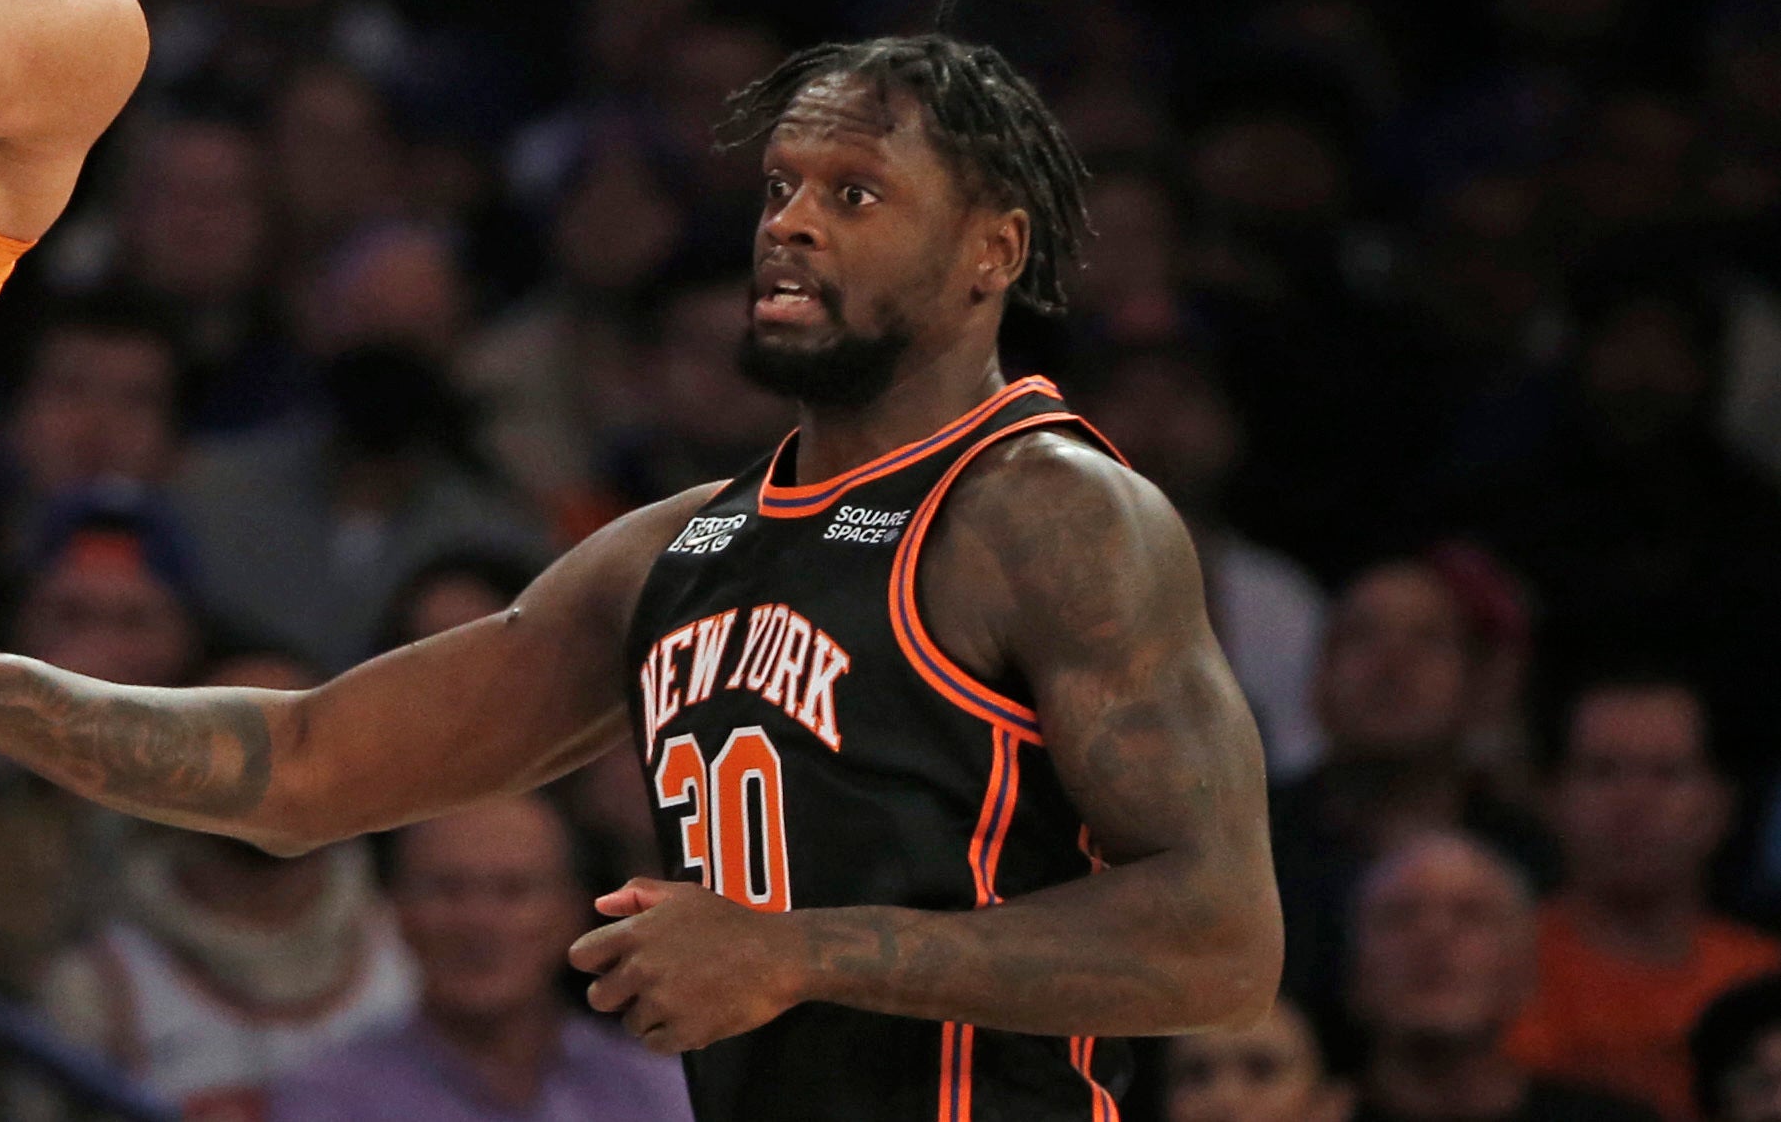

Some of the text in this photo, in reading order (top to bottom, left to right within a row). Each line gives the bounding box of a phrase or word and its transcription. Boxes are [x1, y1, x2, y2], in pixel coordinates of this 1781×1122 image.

[823, 523, 887, 544] SPACE
[835, 505, 911, 527] SQUARE
[640, 602, 852, 766] NEW YORK
[654, 725, 792, 913] 30
